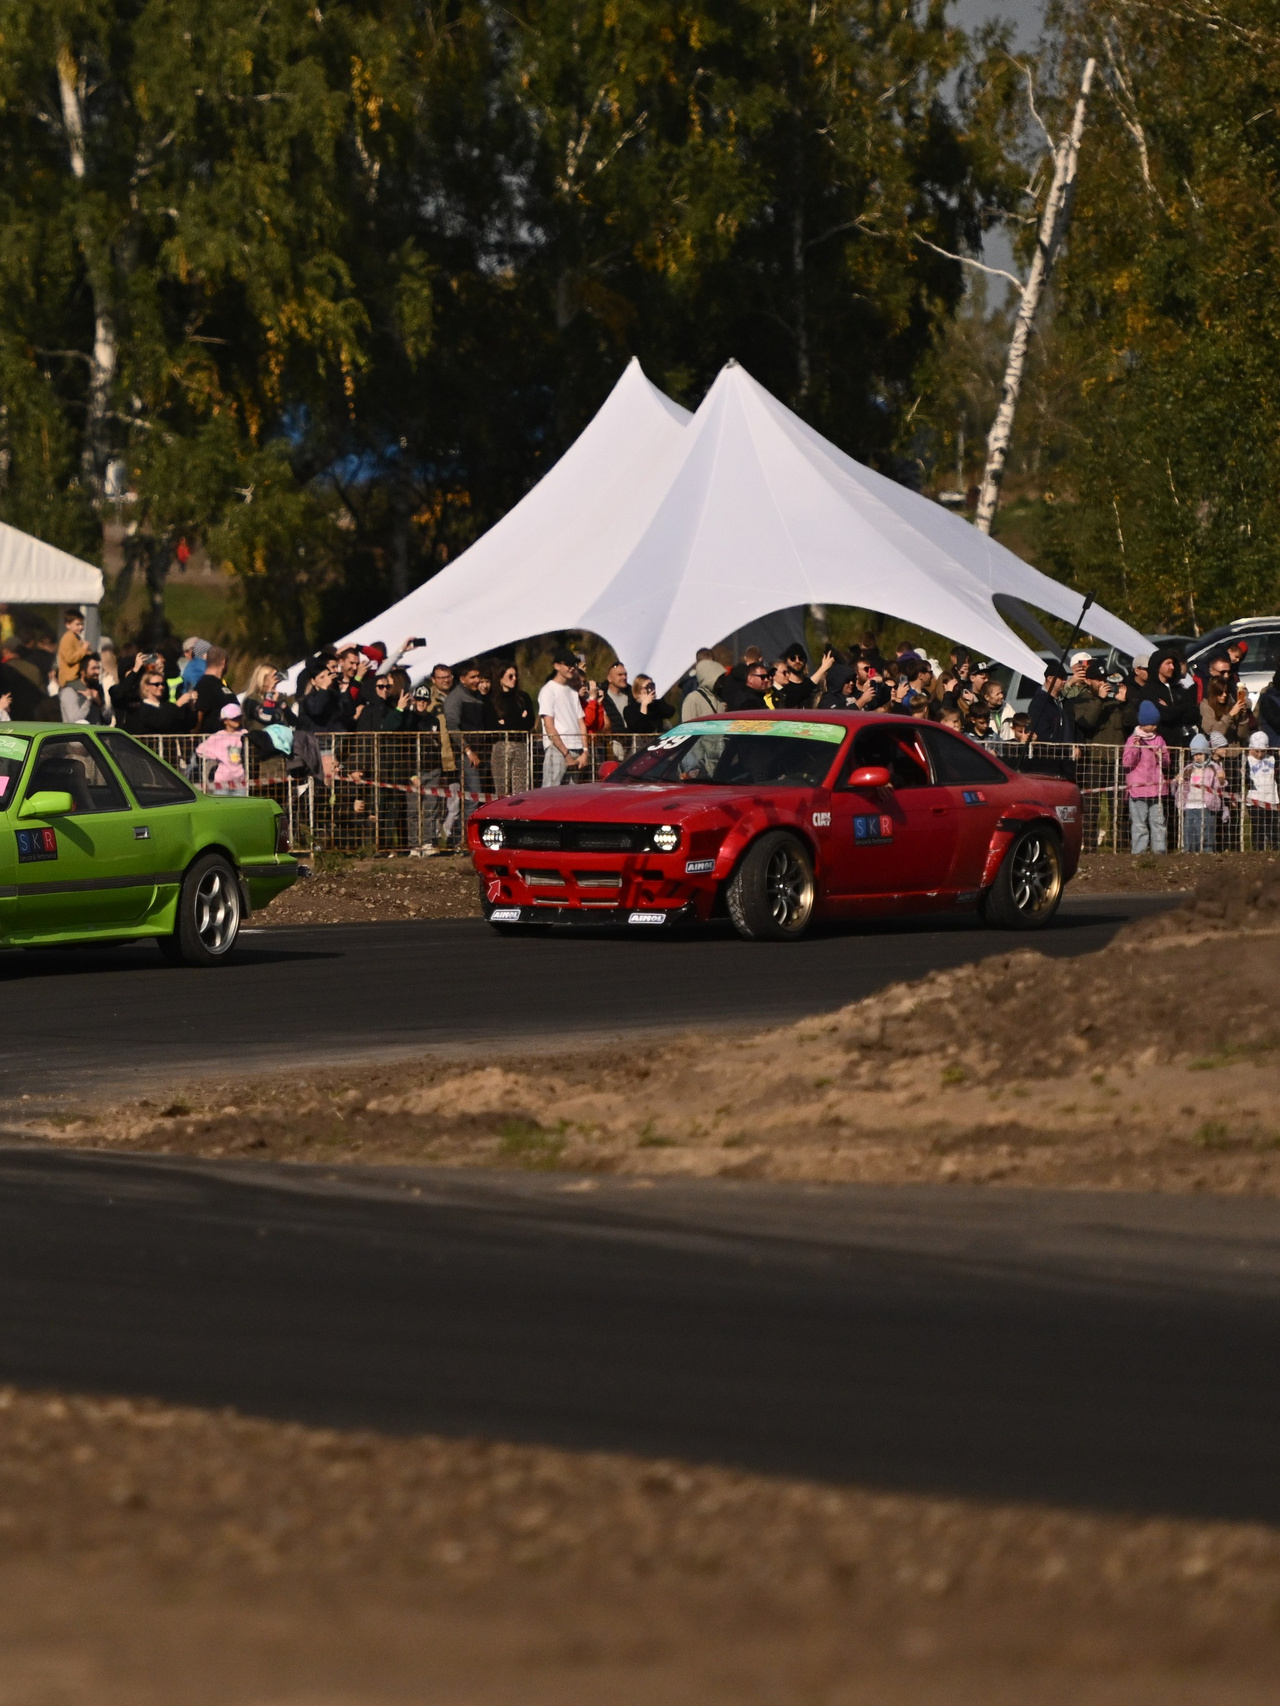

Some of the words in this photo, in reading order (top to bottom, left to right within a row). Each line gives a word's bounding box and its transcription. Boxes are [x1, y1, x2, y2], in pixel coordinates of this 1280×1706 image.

[647, 735, 692, 751] 39
[856, 818, 891, 837] SKR
[20, 831, 54, 851] SKR
[687, 861, 714, 872] AIMOL
[494, 911, 519, 919] AIMOL
[630, 914, 665, 922] AIMOL
